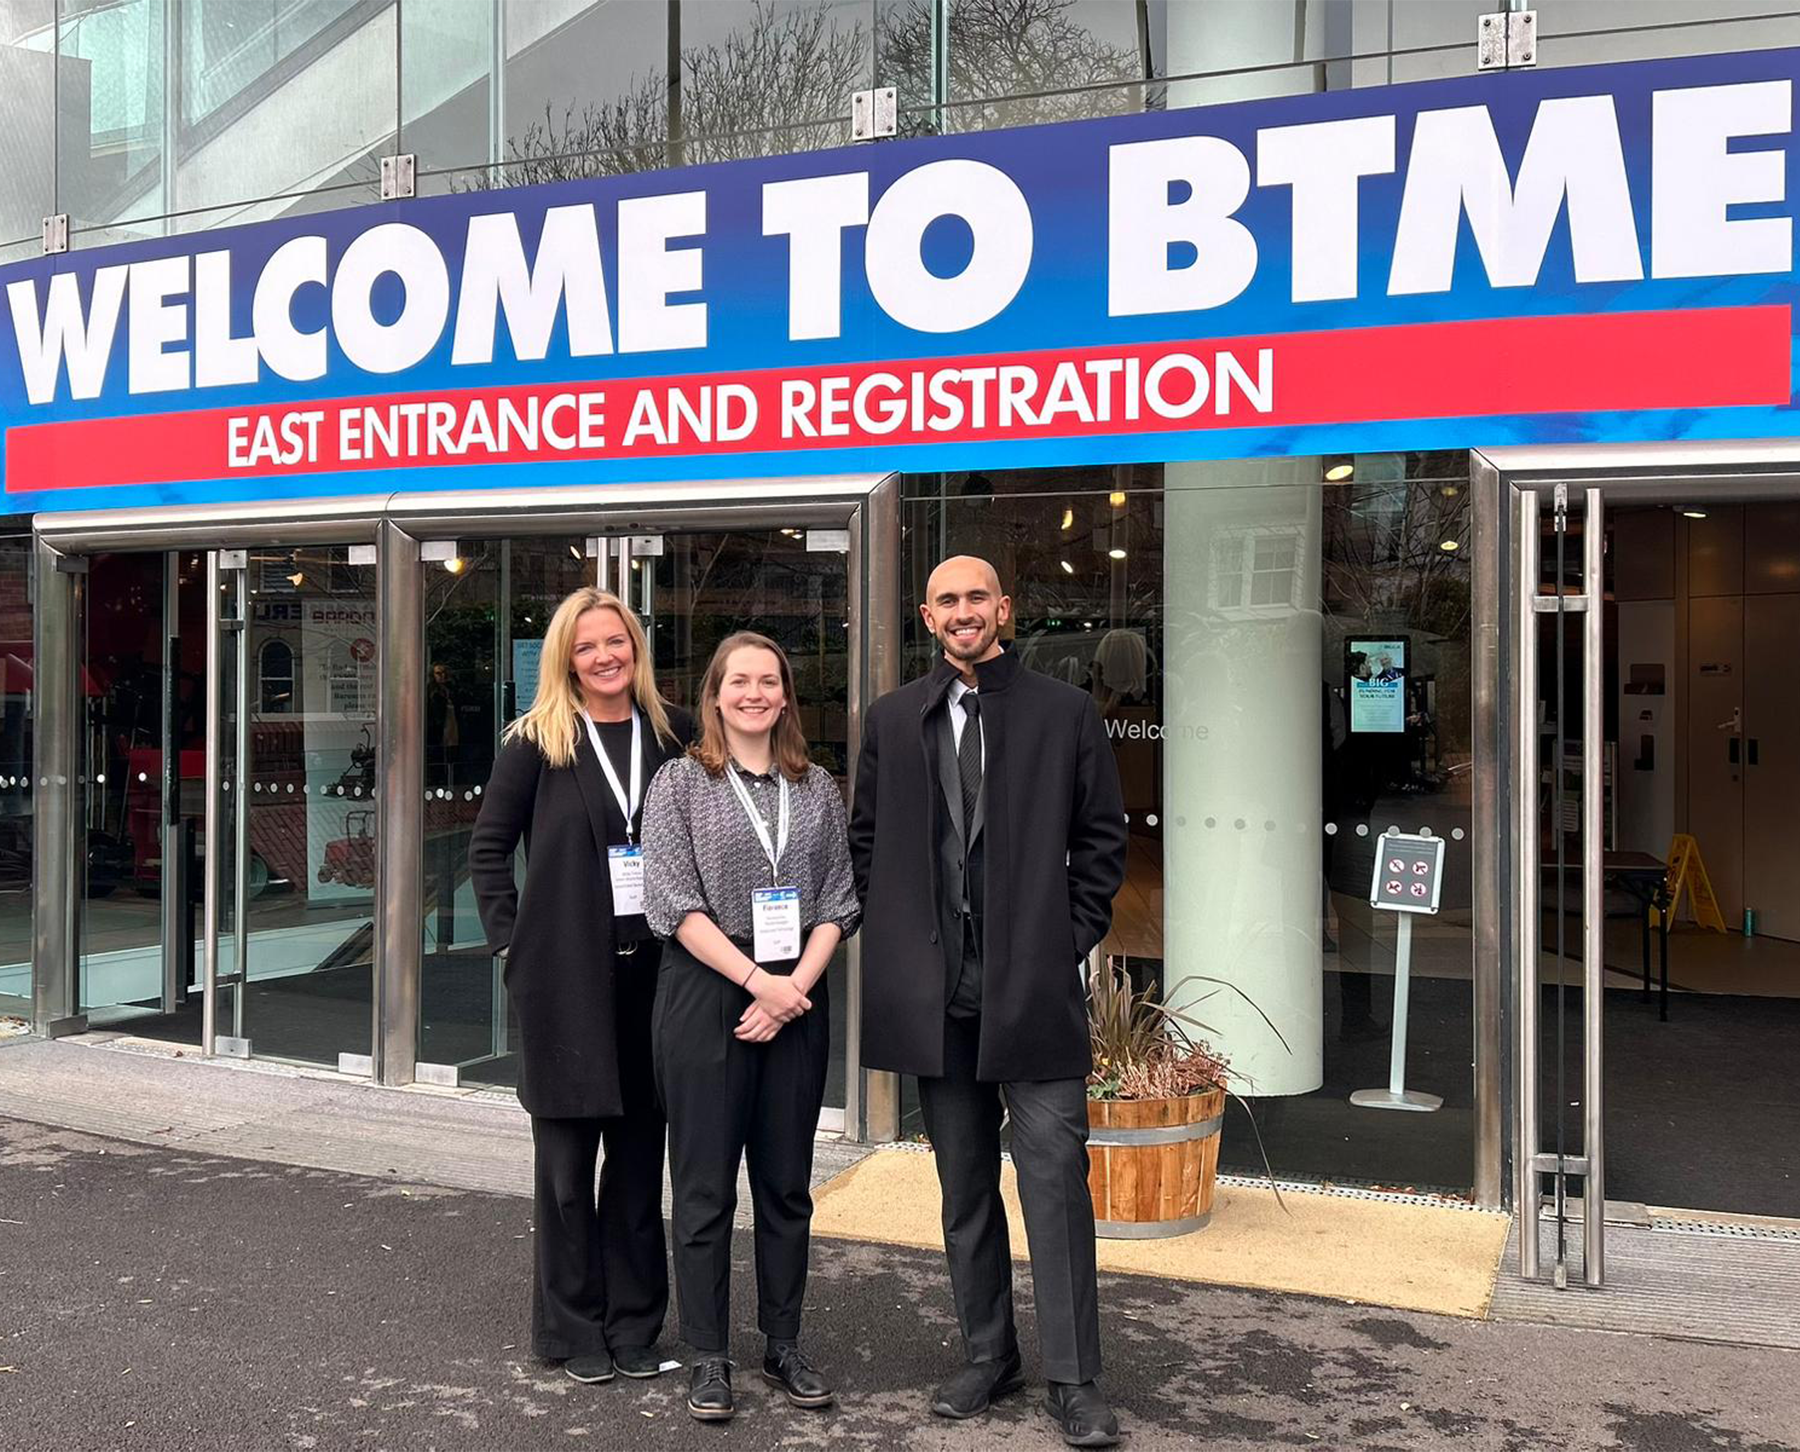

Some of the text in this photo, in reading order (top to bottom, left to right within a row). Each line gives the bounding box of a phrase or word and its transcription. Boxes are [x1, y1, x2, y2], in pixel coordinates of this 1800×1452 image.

[6, 79, 1793, 405] WELCOME TO BTME
[228, 348, 1273, 468] EAST ENTRANCE AND REGISTRATION
